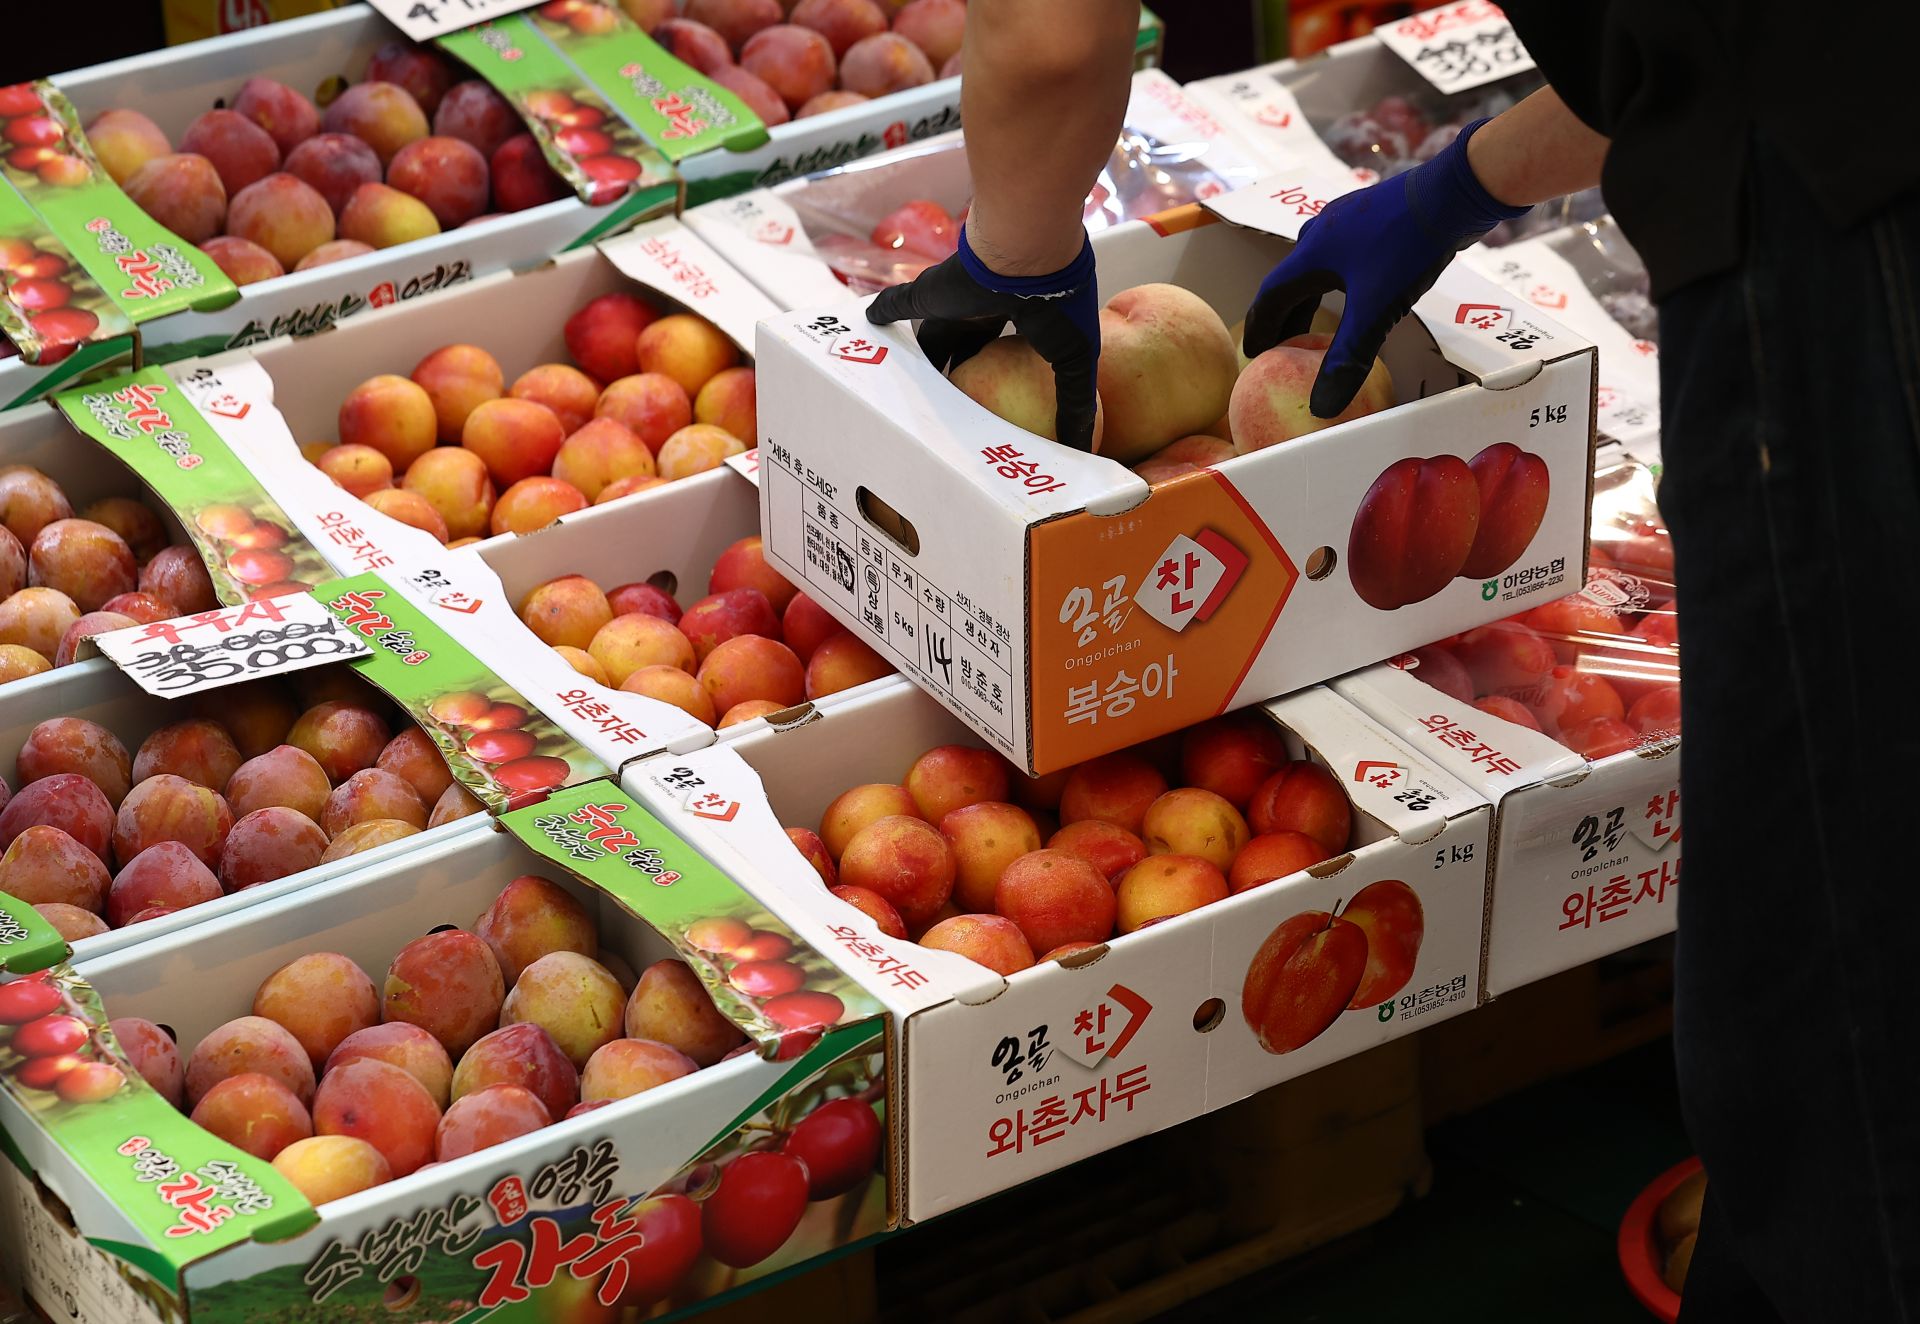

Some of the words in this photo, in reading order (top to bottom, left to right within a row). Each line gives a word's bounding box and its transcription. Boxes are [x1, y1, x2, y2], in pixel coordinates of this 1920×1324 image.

[1270, 186, 1328, 216] 숭아
[114, 384, 172, 433] 자두
[1529, 408, 1541, 428] 5
[1545, 404, 1567, 423] kg
[793, 458, 803, 476] 후
[980, 443, 1067, 496] 복숭아
[316, 511, 395, 572] 와촌자두
[1503, 557, 1565, 589] 하양농협
[330, 591, 394, 636] 자두
[864, 607, 884, 635] 보통
[868, 590, 880, 611] 상
[978, 608, 993, 628] 경북
[994, 623, 1010, 640] 경산
[926, 624, 952, 685] 14
[1065, 639, 1142, 671] Ongolchan
[1064, 654, 1179, 725] 복숭아
[556, 689, 648, 745] 와촌자두
[1417, 714, 1522, 776] 와촌자두
[568, 803, 640, 853] 자두
[1434, 849, 1446, 870] 5
[1451, 843, 1475, 863] kg
[1571, 856, 1629, 880] Ongolchan
[1559, 858, 1681, 931] 와촌자
[826, 924, 930, 990] 와촌자두
[1400, 974, 1467, 1011] 와촌농협
[987, 1064, 1151, 1159] 와촌자두
[995, 1074, 1061, 1105] Ongolchan
[531, 1139, 620, 1207] 영주
[157, 1172, 235, 1237] 자두
[305, 1193, 483, 1304] 소백산
[473, 1198, 644, 1307] 자두
